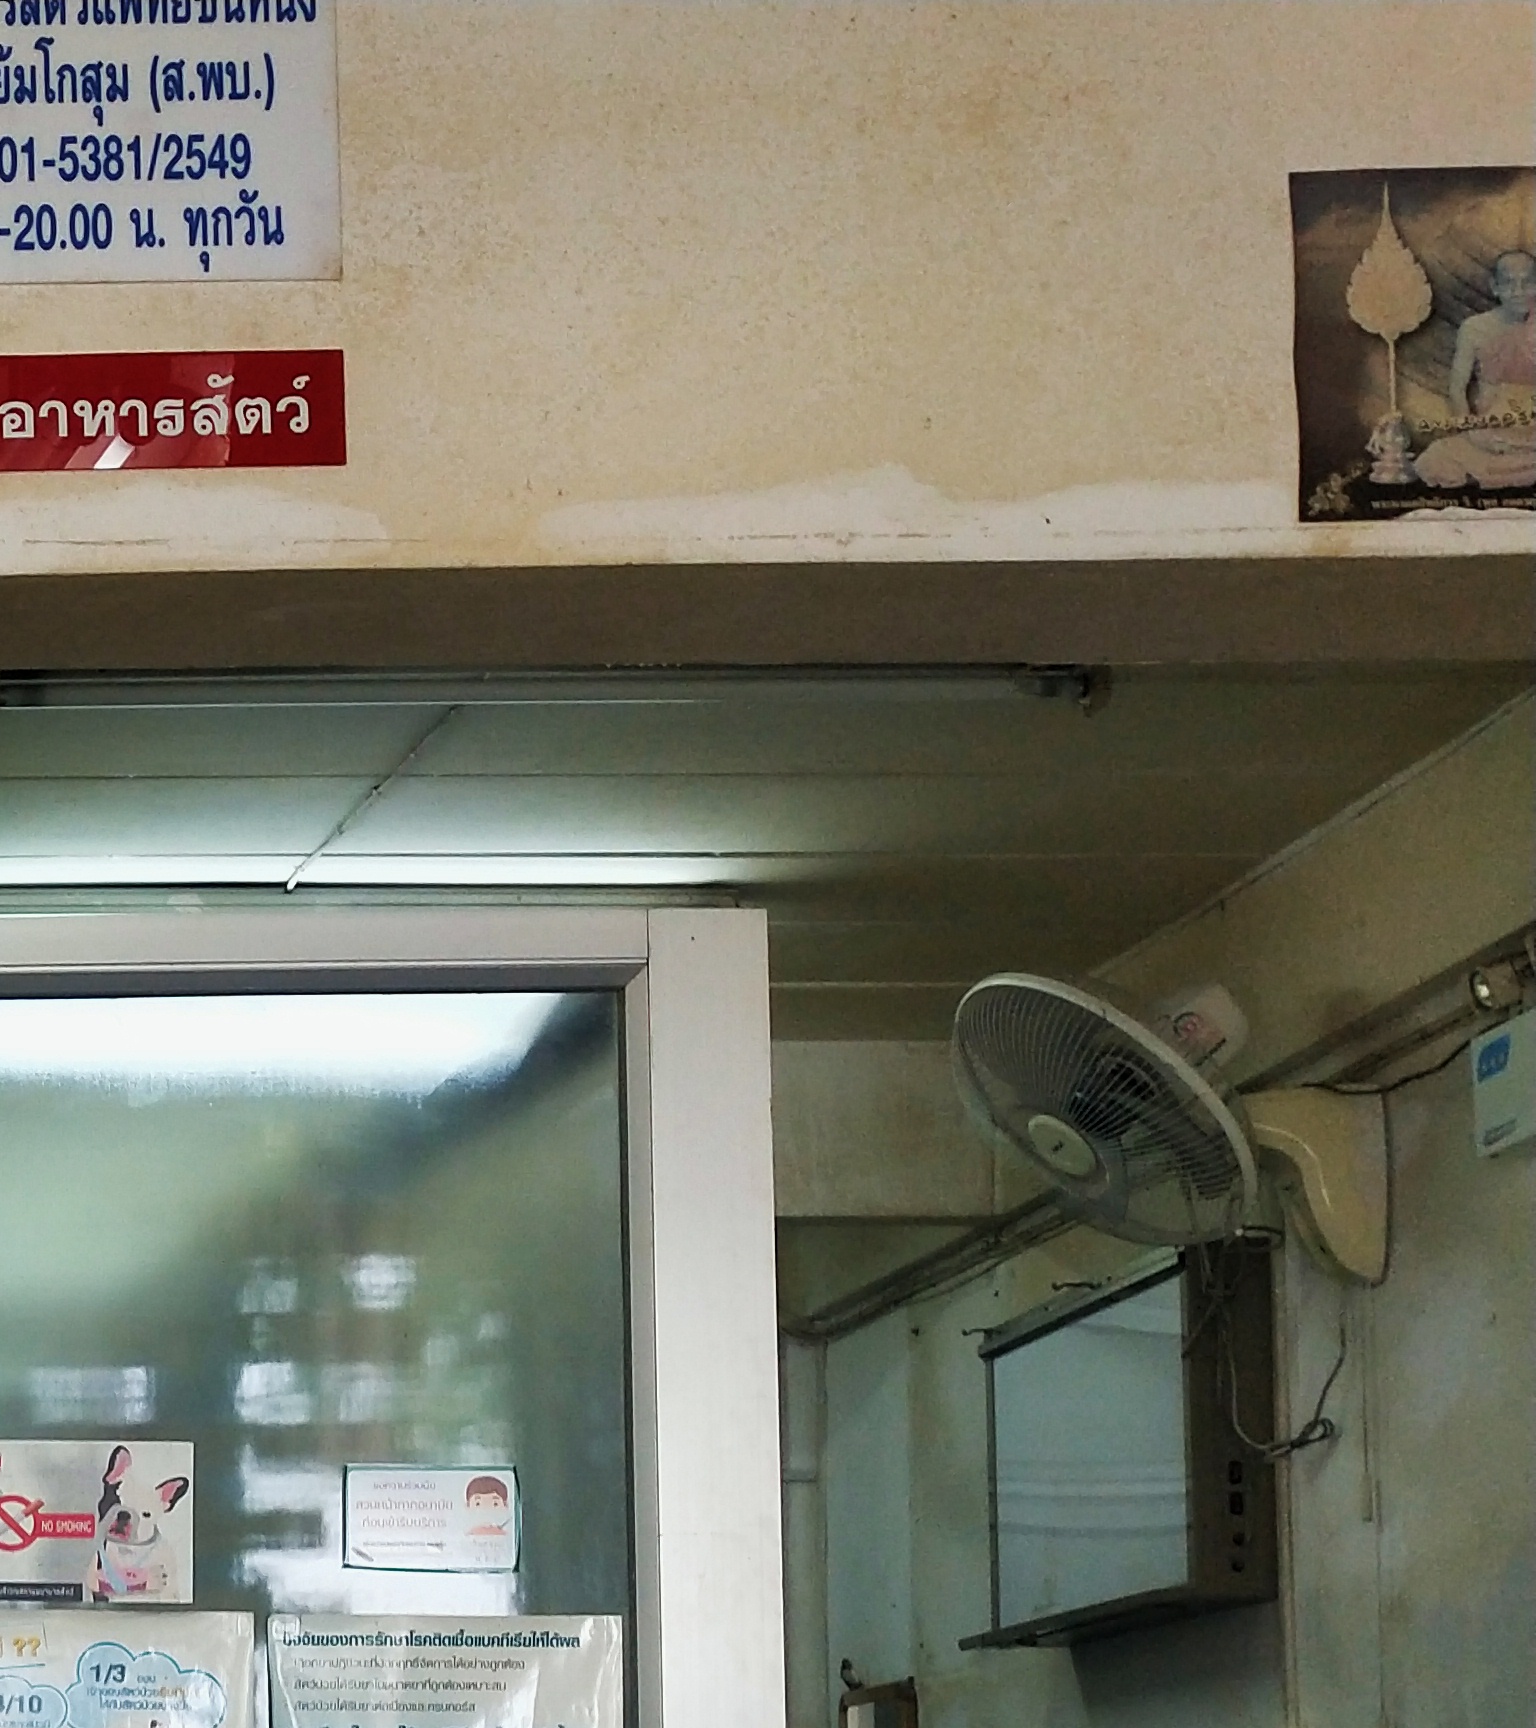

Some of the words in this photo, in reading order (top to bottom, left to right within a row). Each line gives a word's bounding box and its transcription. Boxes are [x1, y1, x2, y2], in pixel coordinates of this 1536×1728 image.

[150, 53, 275, 113] (ส.พบ.)
[131, 211, 166, 249] น.
[186, 190, 285, 272] ทุกวัน
[41, 1520, 54, 1533] NO
[56, 1520, 92, 1533] SMOKING
[13, 1636, 42, 1657] ??
[89, 1663, 126, 1685] 1/3
